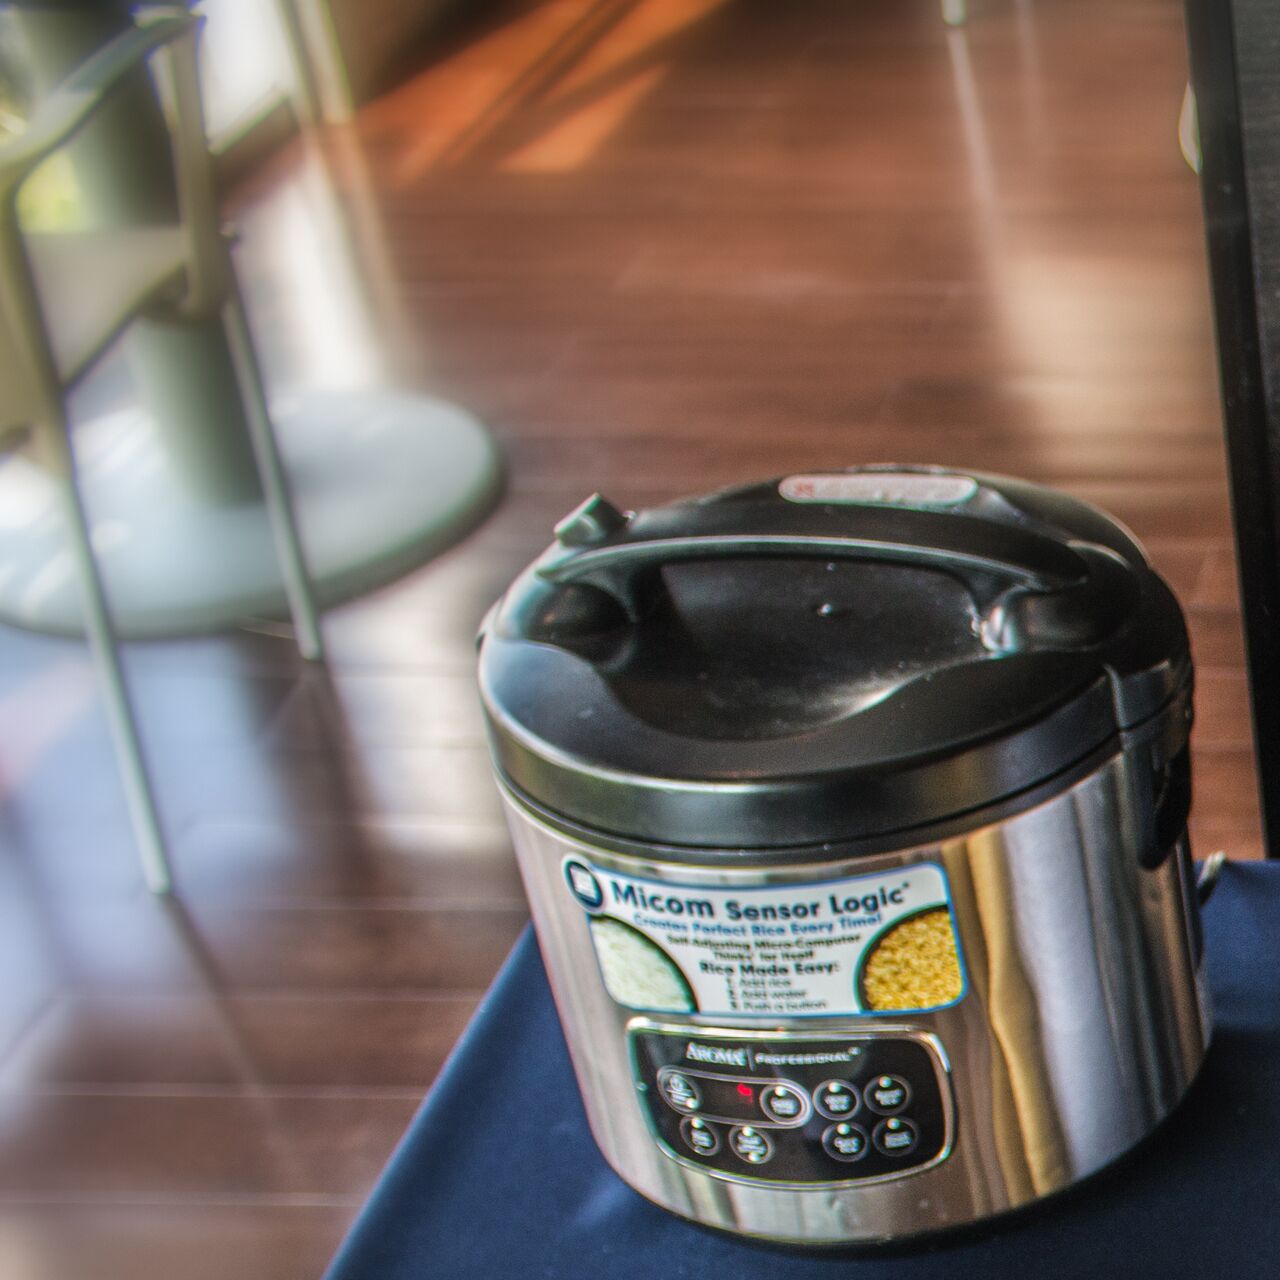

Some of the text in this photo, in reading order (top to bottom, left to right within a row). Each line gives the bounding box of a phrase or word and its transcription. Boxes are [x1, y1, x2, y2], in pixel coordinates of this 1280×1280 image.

[611, 881, 715, 918] Micom
[725, 900, 820, 921] Sensor
[633, 913, 882, 937] Creates Perfect Rice Every Time!
[699, 961, 840, 978] Rice Made Easy:
